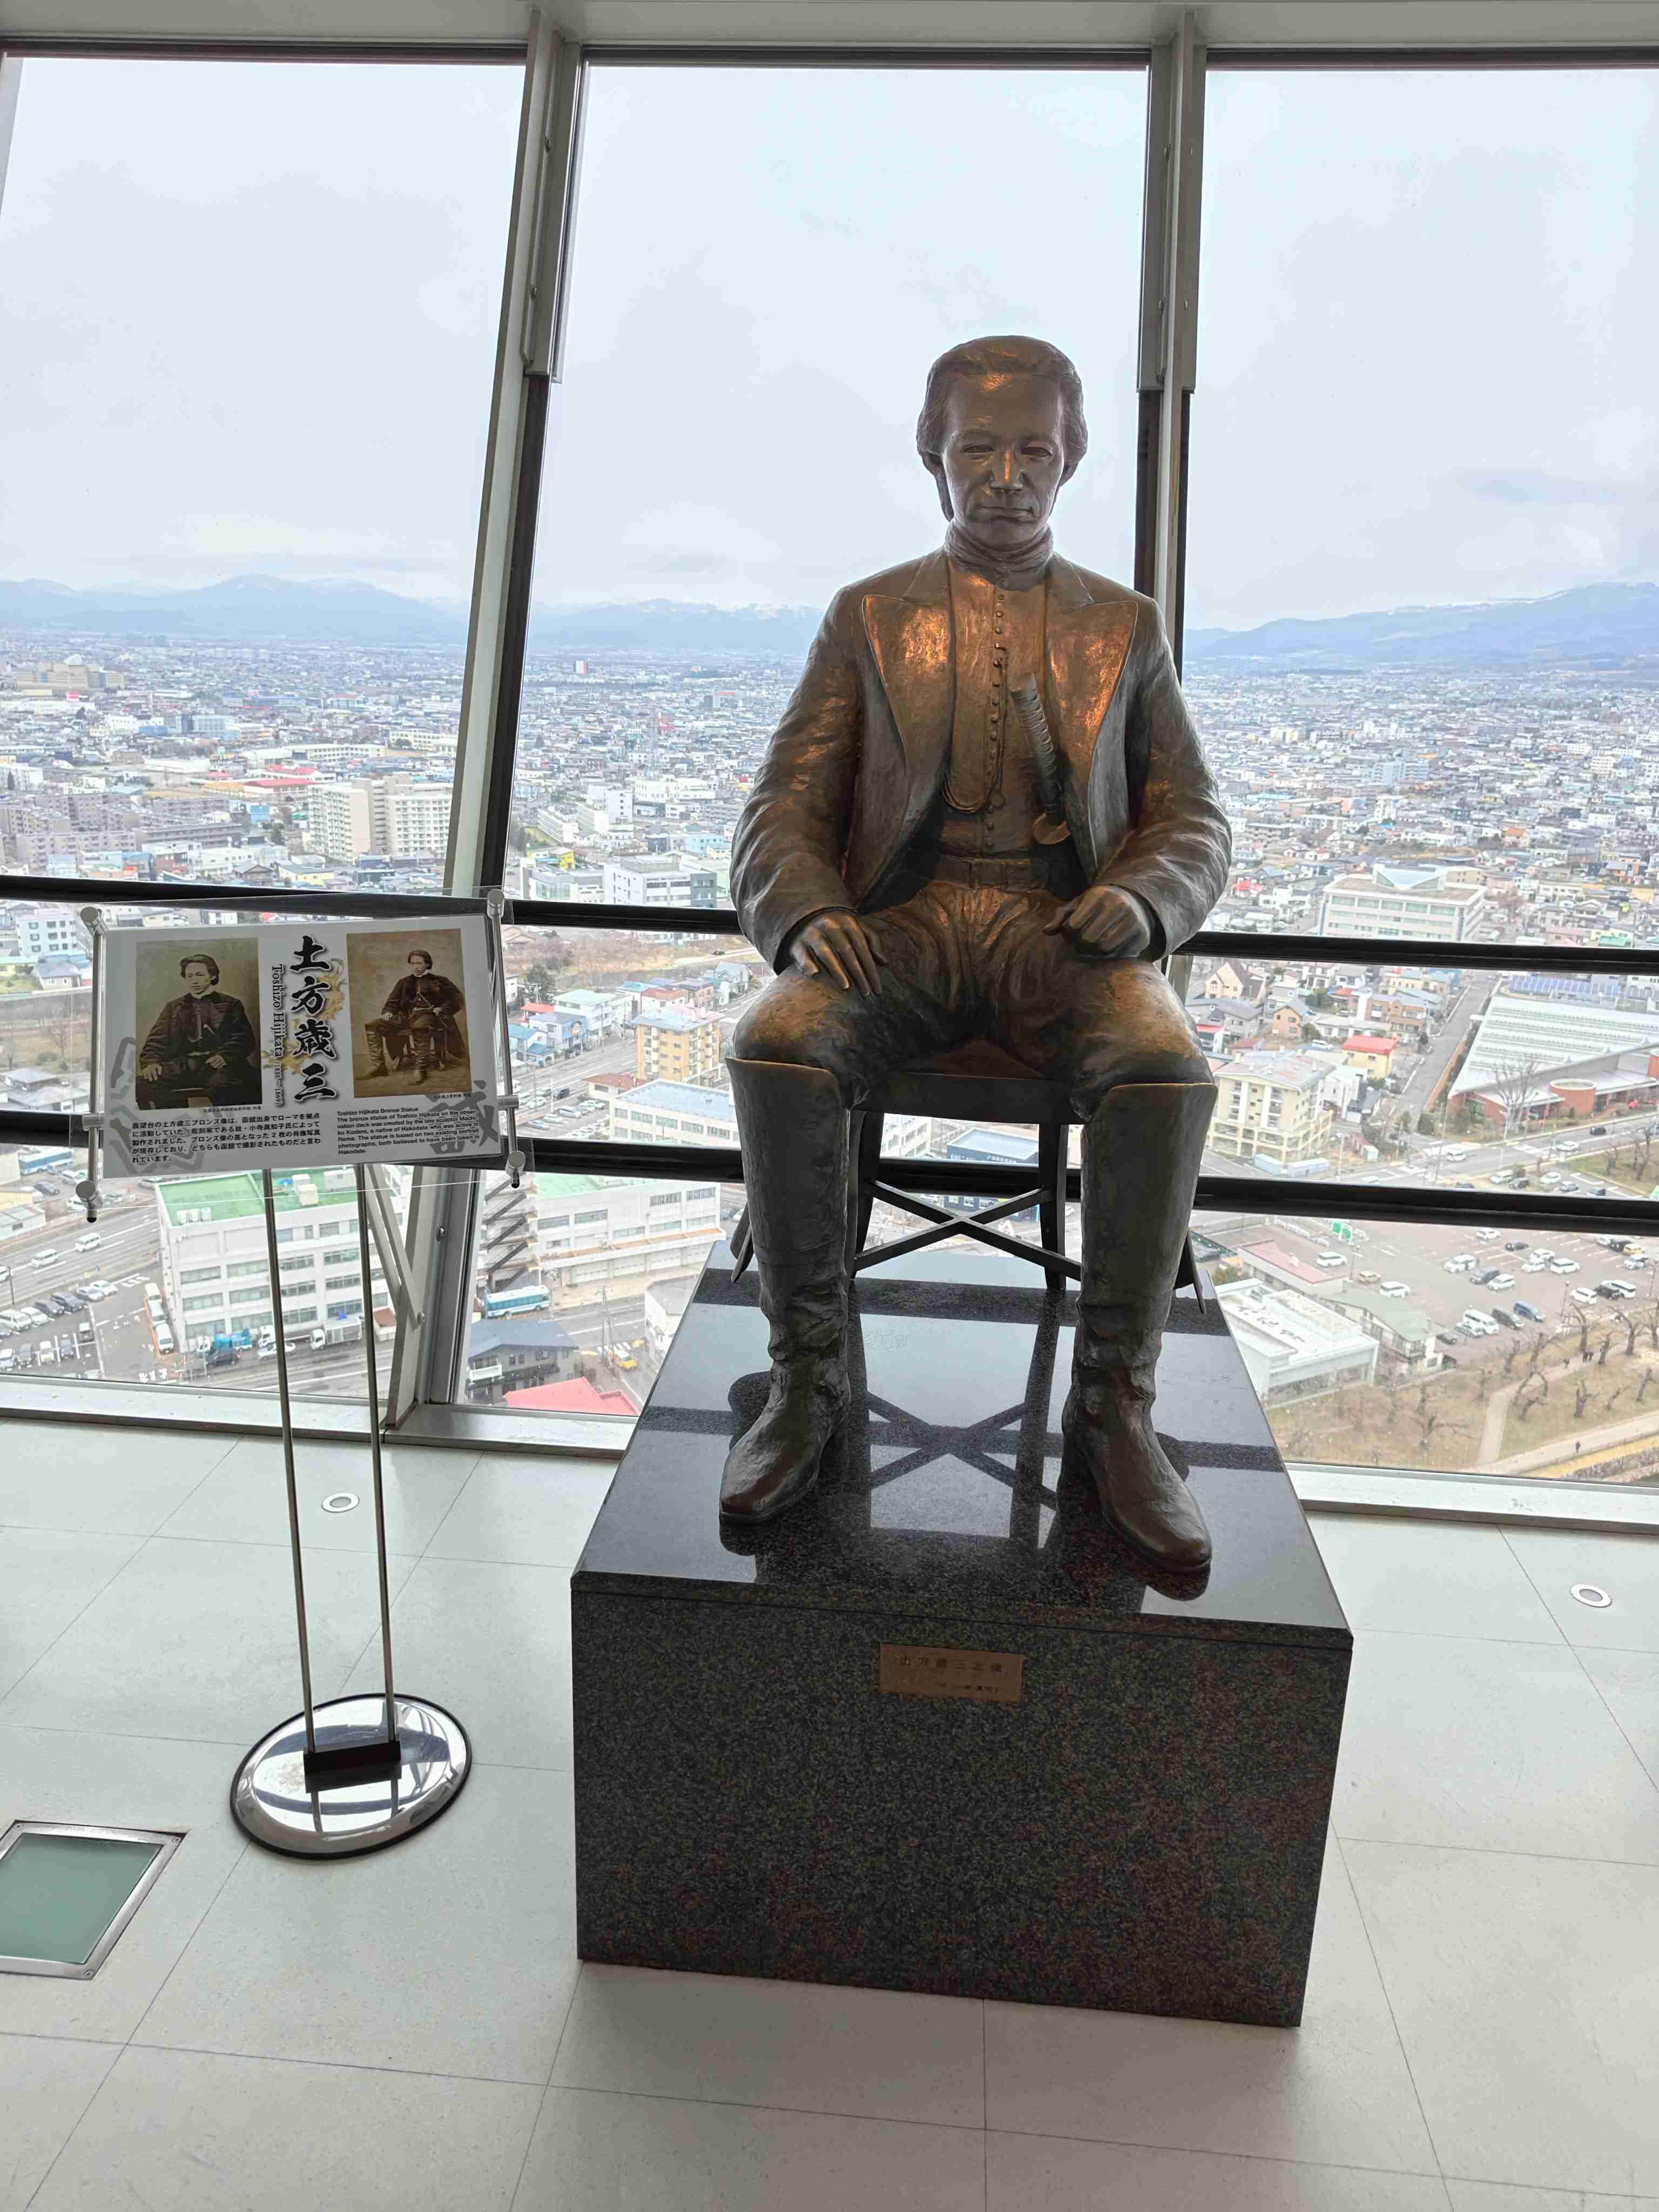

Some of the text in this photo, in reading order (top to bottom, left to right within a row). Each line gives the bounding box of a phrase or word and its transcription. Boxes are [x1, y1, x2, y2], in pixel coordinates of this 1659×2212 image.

[272, 963, 284, 1009] Toshizo
[271, 1013, 285, 1057] Hijikata
[289, 934, 336, 1102] 土方歳三
